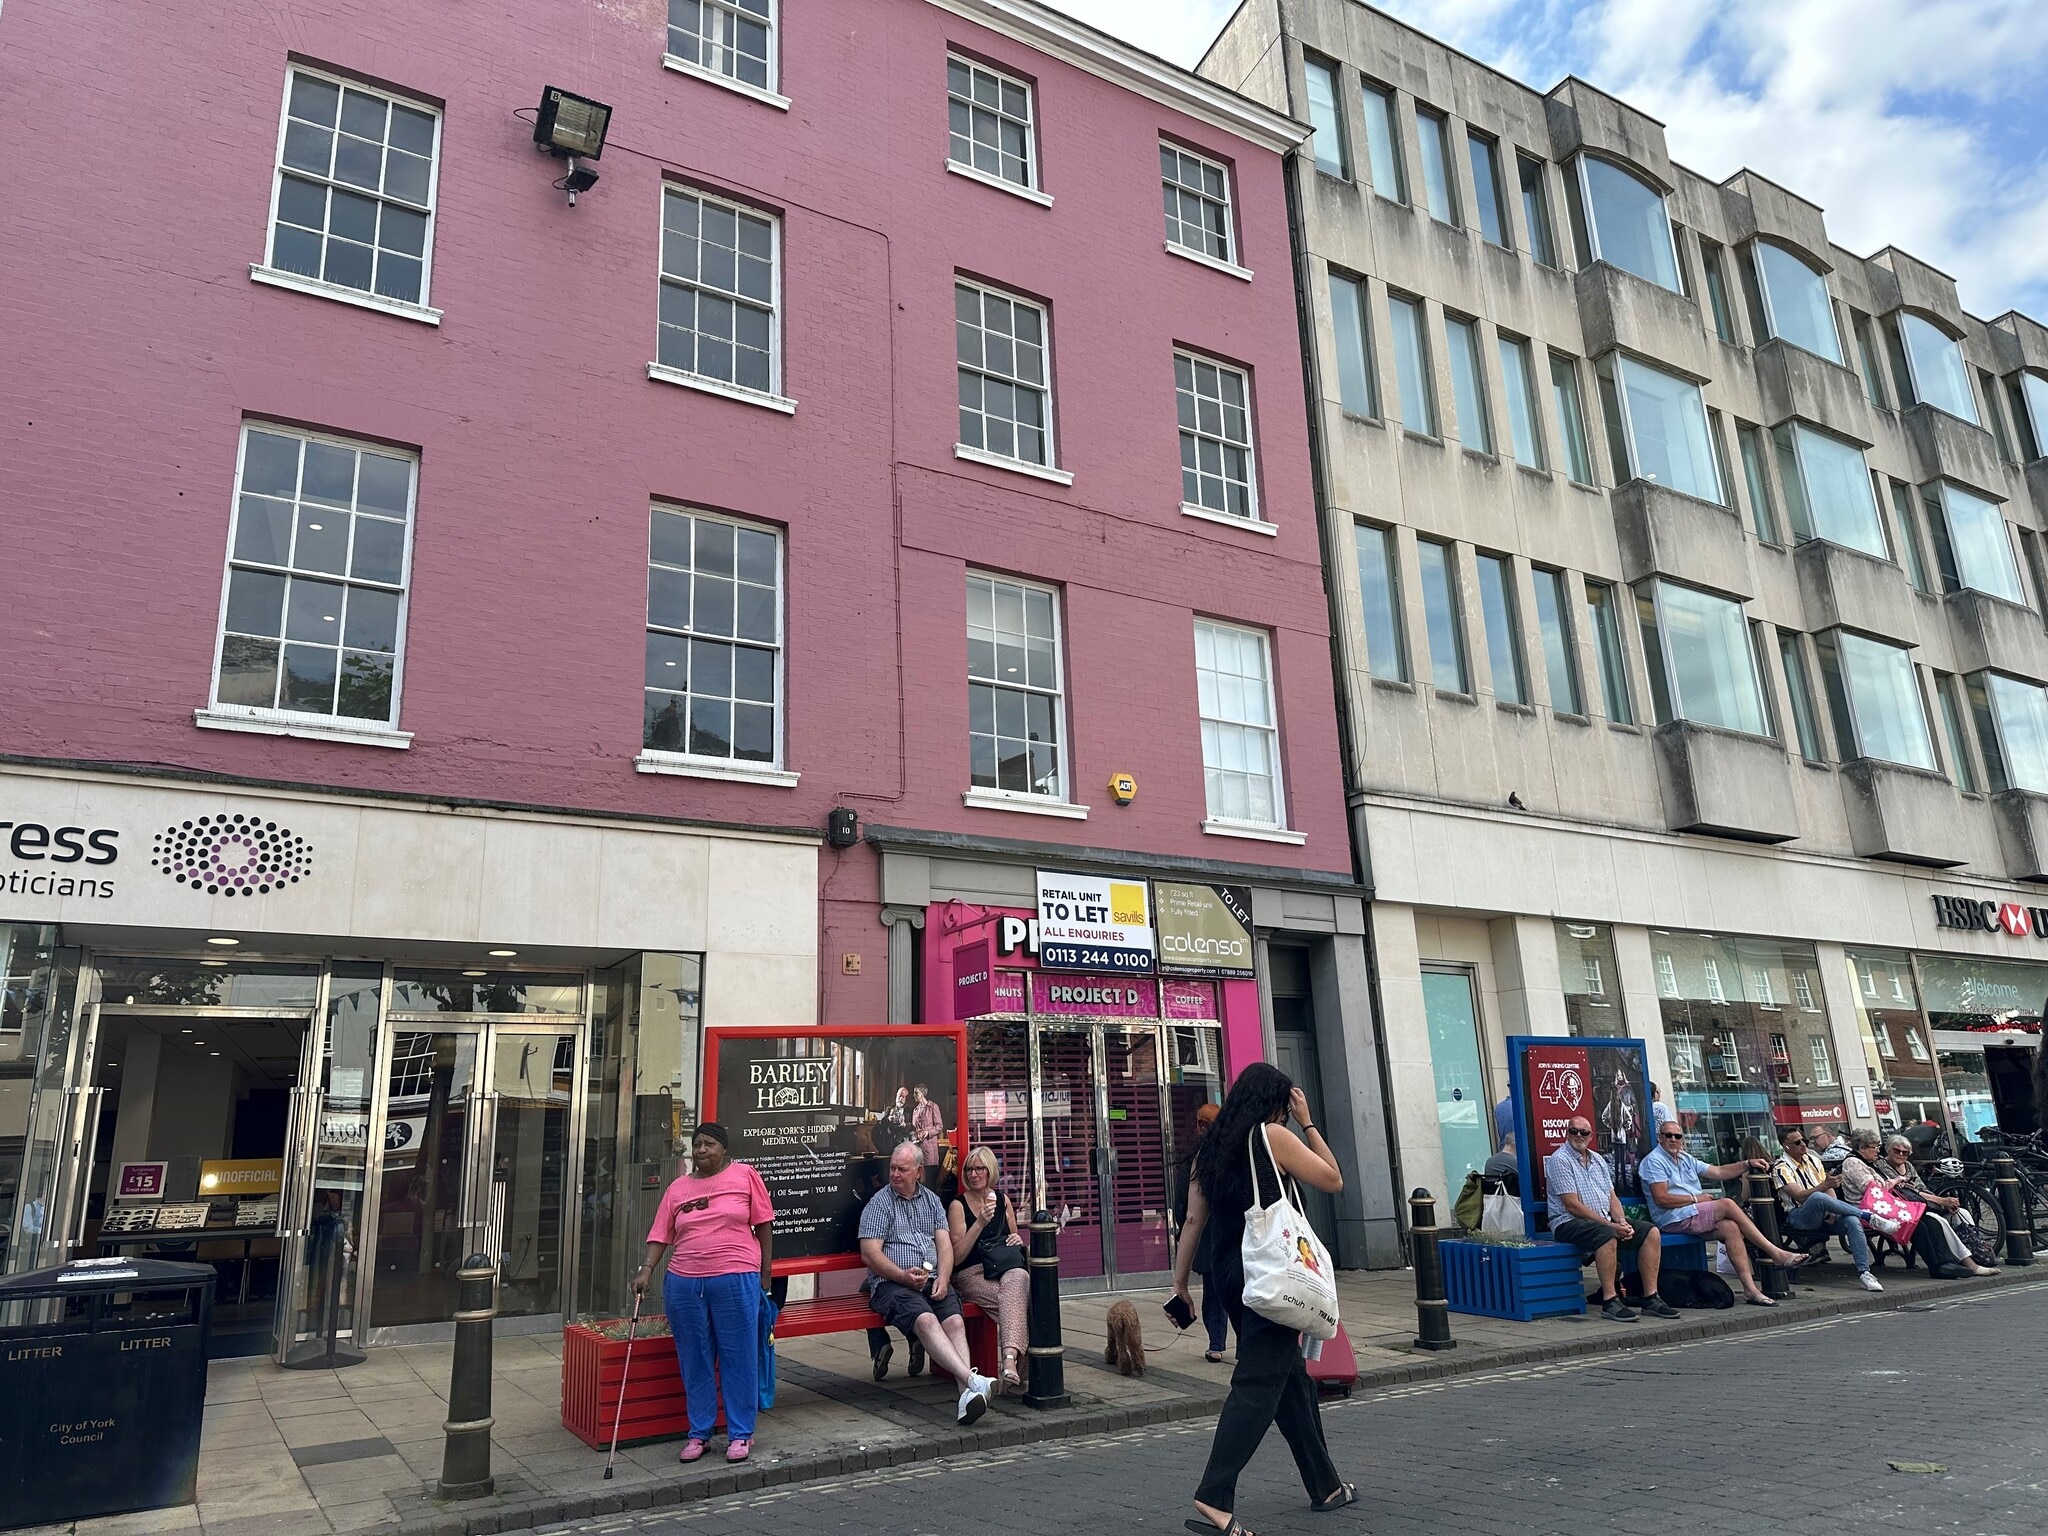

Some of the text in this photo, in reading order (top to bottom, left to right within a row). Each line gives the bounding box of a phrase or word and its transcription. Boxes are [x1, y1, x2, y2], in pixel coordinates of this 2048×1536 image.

[1043, 889, 1102, 902] RETAIL UNIT
[1170, 898, 1186, 906] Prime
[1187, 900, 1202, 908] Retail
[1221, 888, 1250, 923] TO LET
[1043, 903, 1108, 923] TO LET
[1113, 911, 1144, 924] savills
[1171, 908, 1183, 916] Fully
[1931, 894, 2000, 933] HSBC
[1044, 927, 1125, 941] ALL ENQUIRIES
[1163, 932, 1243, 956] colenso
[1046, 948, 1149, 968] 0113 244 0100
[958, 971, 987, 986] PROJECT D
[1962, 976, 2019, 999] Welcome
[1050, 985, 1139, 1005] PROJECT D
[1175, 995, 1203, 1005] COFFEE
[750, 1062, 832, 1084] BARLEY
[743, 1124, 836, 1137] EXPLORE YORK'S HIDDEN
[1544, 1130, 1561, 1138] REAL
[762, 1134, 818, 1146] MEDIEVAL GEM
[129, 1176, 153, 1187] £15
[217, 1170, 278, 1183] UNOFFICIAL
[795, 1172, 811, 1180] Barley
[810, 1170, 821, 1178] Hall
[773, 1206, 809, 1217] BOOK NOW
[785, 1216, 825, 1226] barleyhall.co.uk
[1283, 1295, 1305, 1309] schuh
[120, 1337, 171, 1351] LITTER
[8, 1346, 62, 1361] LITTER
[50, 1418, 115, 1434] City of York
[60, 1431, 103, 1445] Council
